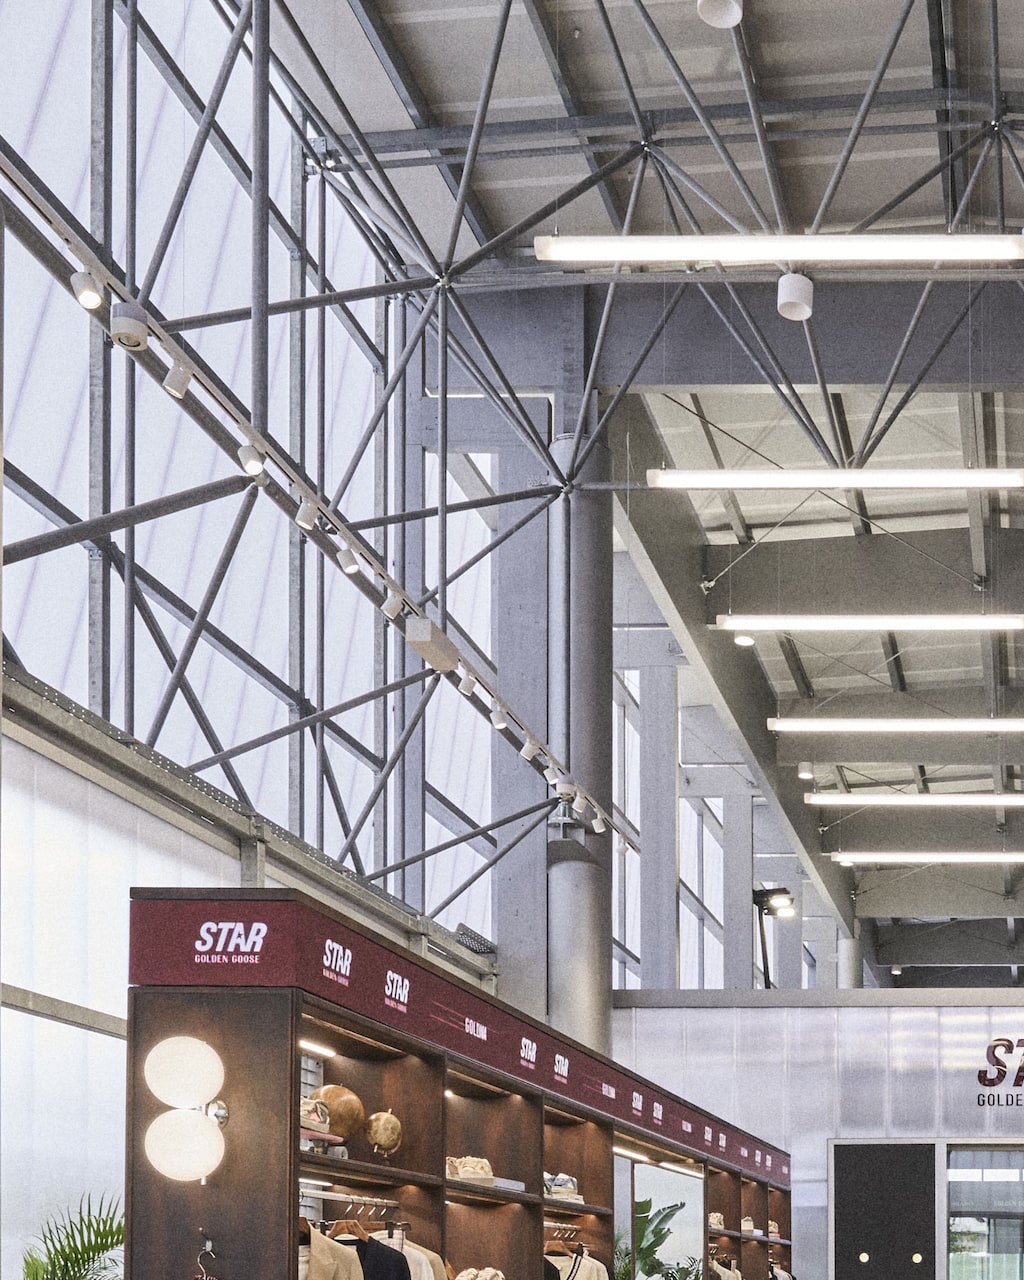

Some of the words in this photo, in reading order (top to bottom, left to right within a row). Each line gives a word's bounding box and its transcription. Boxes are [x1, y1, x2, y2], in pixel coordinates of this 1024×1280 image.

[195, 921, 268, 952] STAR
[194, 954, 228, 964] GOLDEN
[231, 955, 260, 964] GOOSE
[323, 939, 352, 977] STAR
[384, 970, 410, 1004] STAR
[520, 1037, 537, 1063] STAR
[554, 1053, 569, 1078] STAR
